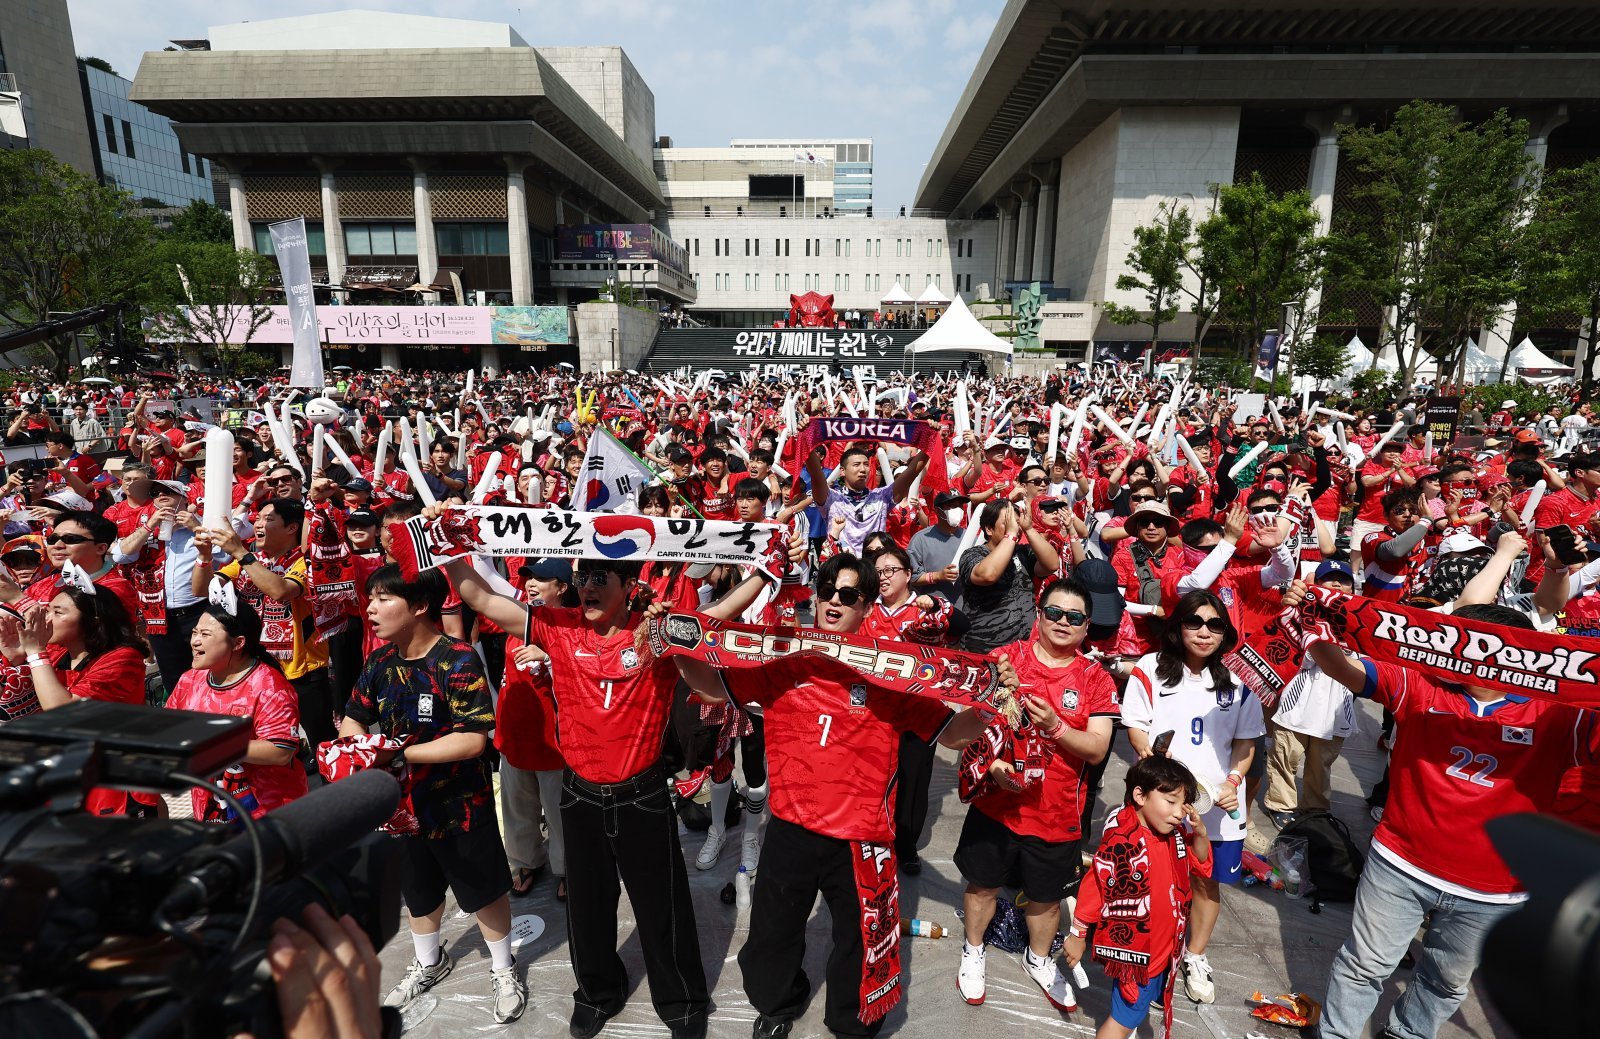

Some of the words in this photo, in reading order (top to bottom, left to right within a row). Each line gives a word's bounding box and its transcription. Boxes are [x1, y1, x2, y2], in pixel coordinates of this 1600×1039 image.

[595, 230, 633, 249] TRIBE
[413, 312, 446, 338] 넘어
[733, 332, 776, 356] 우리가
[778, 332, 835, 356] 깨어나는
[838, 332, 867, 357] 순간
[824, 420, 906, 439] KOREA
[1429, 422, 1452, 431] 장애인
[542, 548, 584, 556] TOGETHER
[715, 553, 757, 562] TOMORROW
[1330, 560, 1341, 570] LA
[801, 631, 843, 641] FOREVER
[1374, 610, 1459, 655] Red
[874, 671, 885, 679] GO
[885, 674, 895, 682] ON
[1398, 646, 1473, 675] REPUBLIC
[1476, 665, 1497, 679] OF
[1500, 669, 1557, 694] KOREA
[818, 713, 832, 747] 7
[1190, 716, 1203, 746] 9
[1445, 745, 1498, 788] 22
